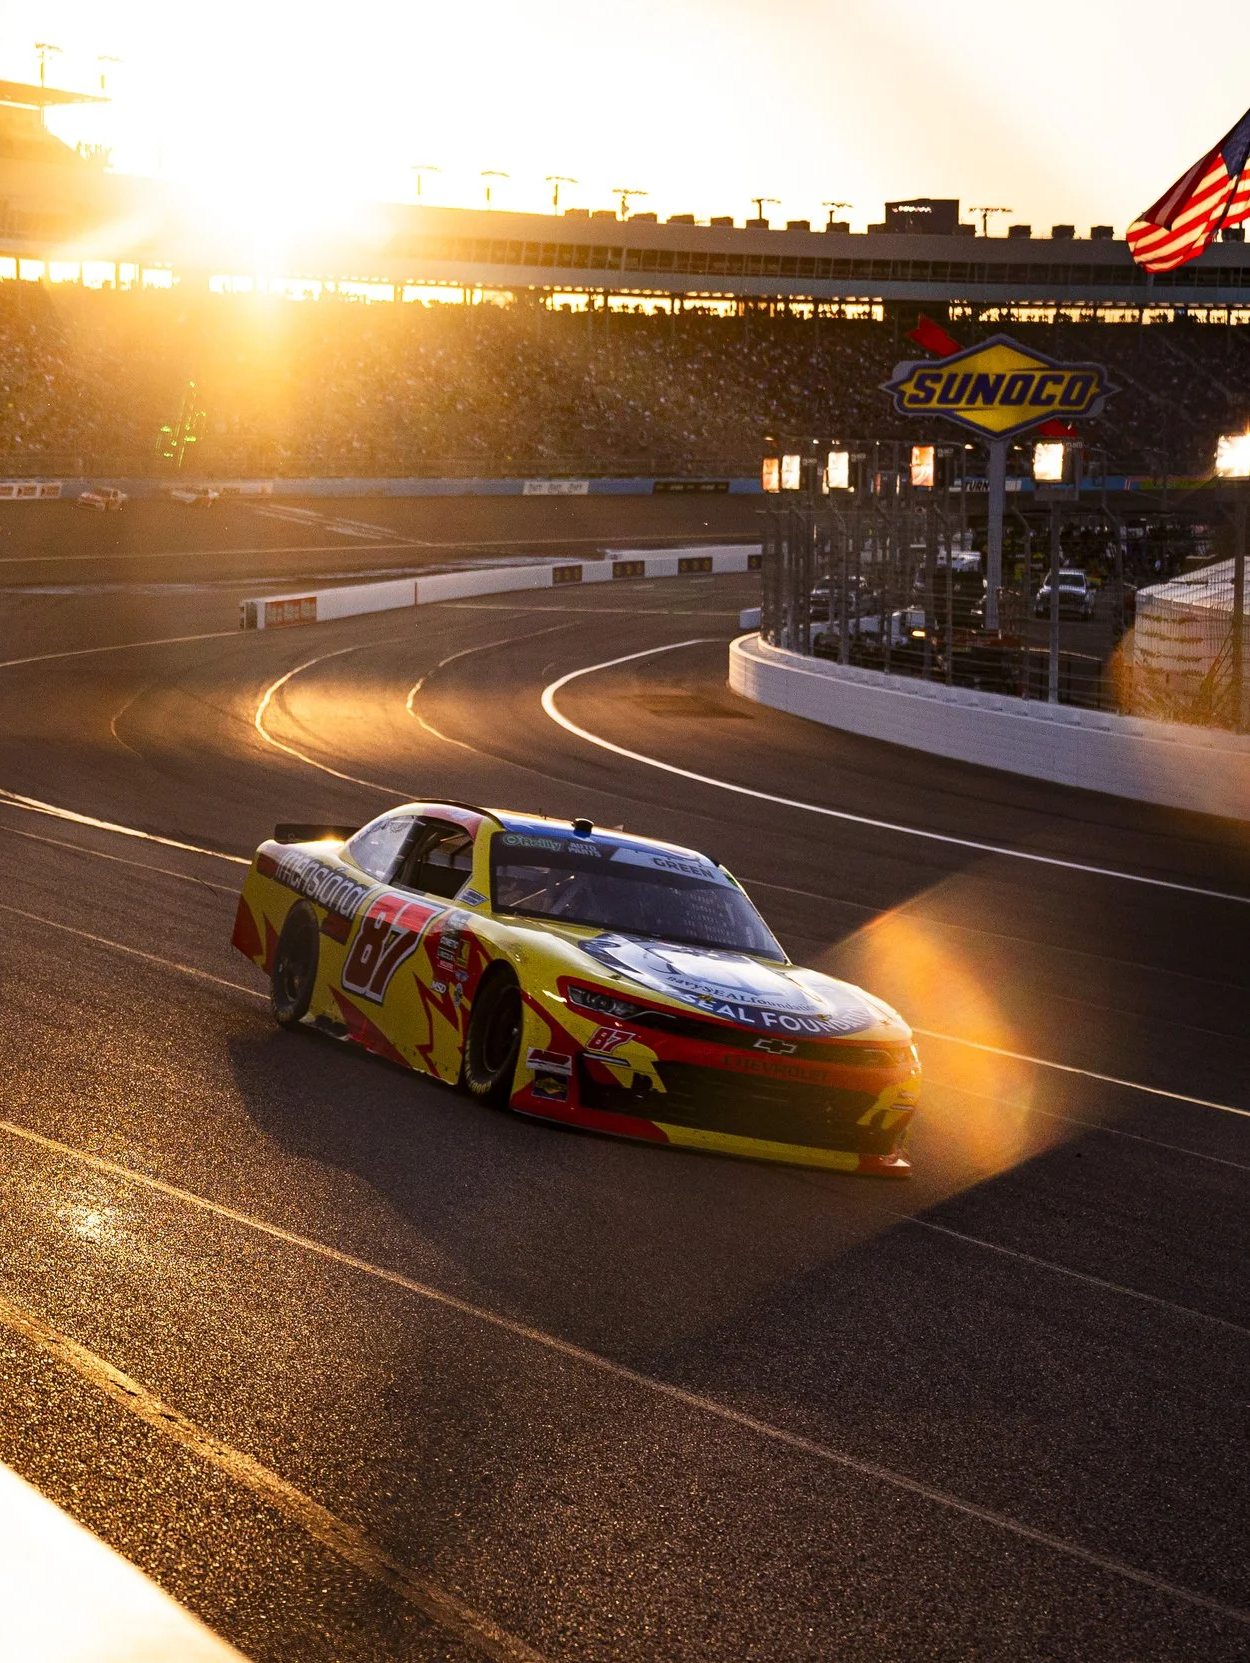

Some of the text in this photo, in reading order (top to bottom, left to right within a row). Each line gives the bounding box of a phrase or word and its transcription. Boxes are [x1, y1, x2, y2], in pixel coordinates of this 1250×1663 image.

[907, 372, 1095, 407] SUNOCO
[502, 833, 563, 852] O'Reilly
[567, 847, 602, 858] PARTS
[569, 842, 598, 852] AUTO
[652, 856, 715, 880] GREEN
[341, 890, 448, 1007] 87
[679, 993, 755, 1023] SEAL
[586, 1026, 637, 1054] 87
